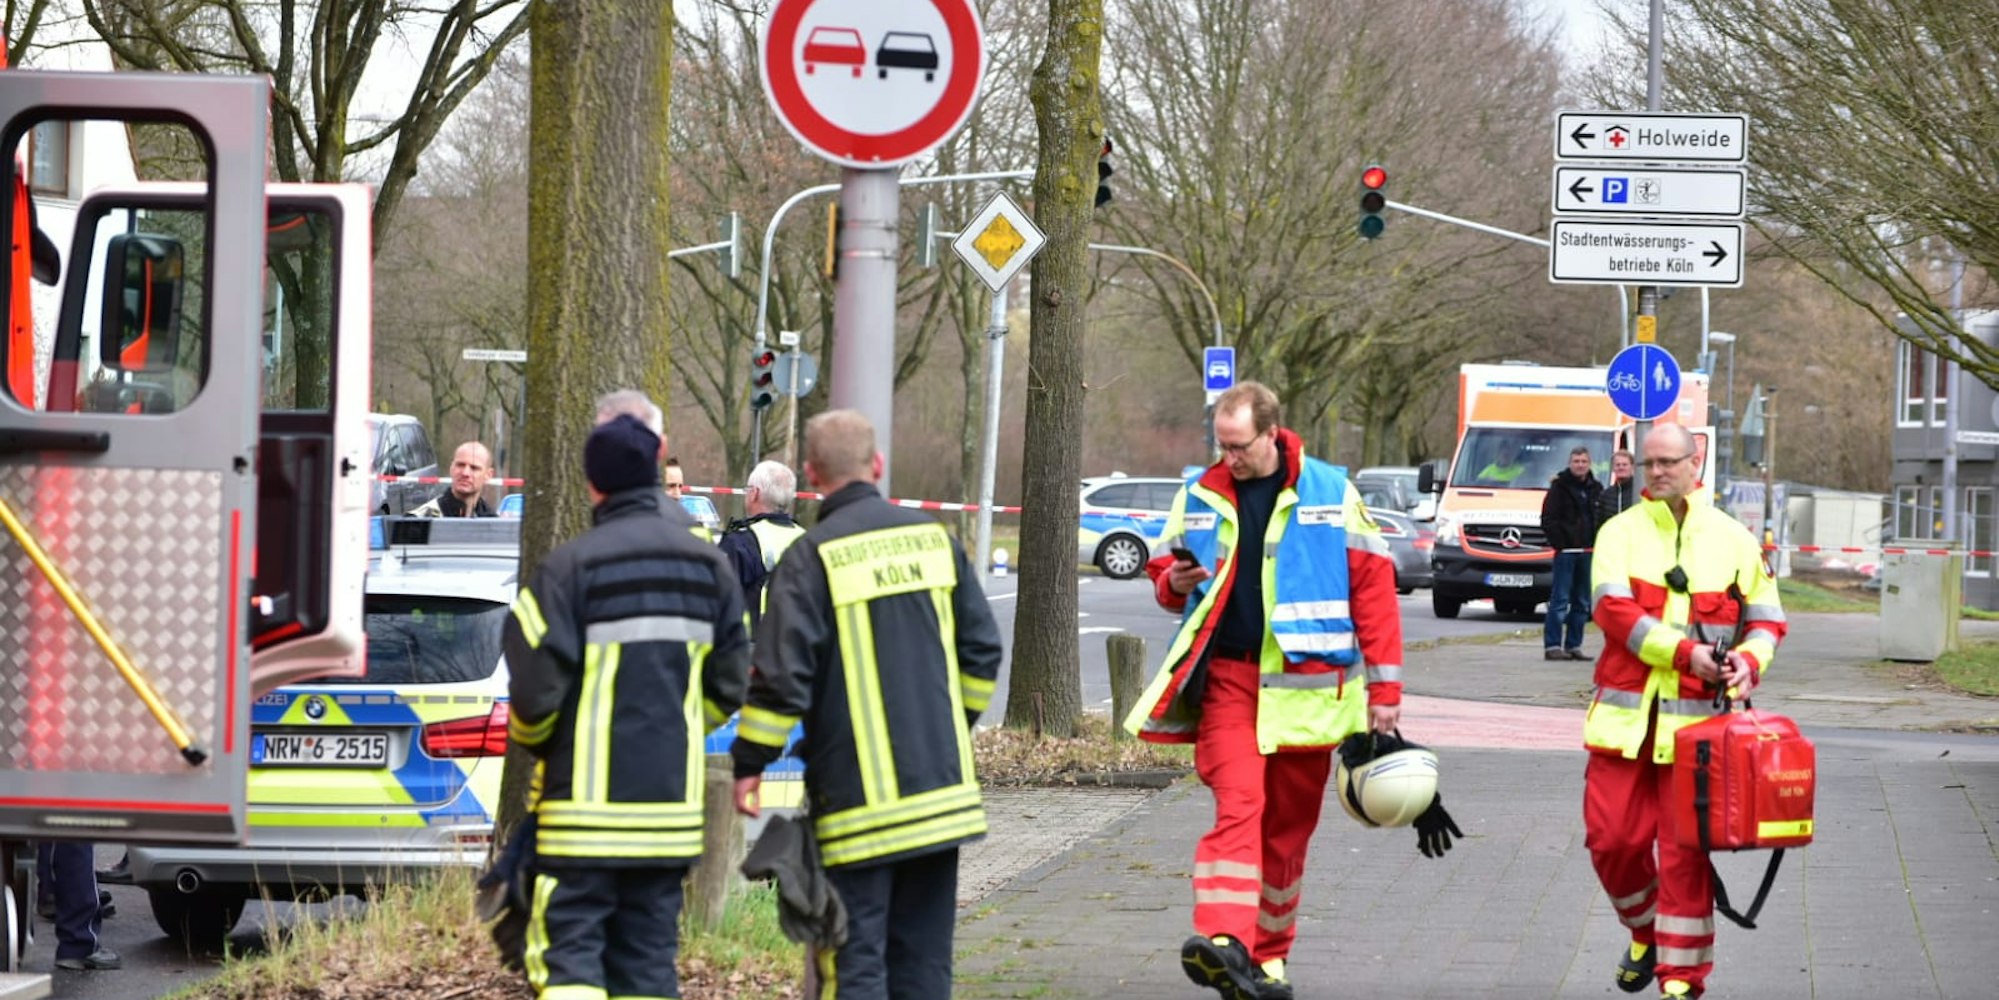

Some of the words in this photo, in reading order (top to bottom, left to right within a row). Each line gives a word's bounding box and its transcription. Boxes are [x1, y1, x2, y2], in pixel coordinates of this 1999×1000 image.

[1638, 128, 1731, 147] Holweide
[1607, 180, 1623, 201] P
[1560, 231, 1694, 252] Stadtentwässerungs-
[1609, 256, 1660, 272] betriebe
[1666, 257, 1694, 273] Köln
[828, 532, 945, 568] BERUFSFEUERWEHR
[873, 561, 923, 588] KÖLN
[263, 737, 302, 760] NRW
[313, 737, 385, 760] 6-2515
